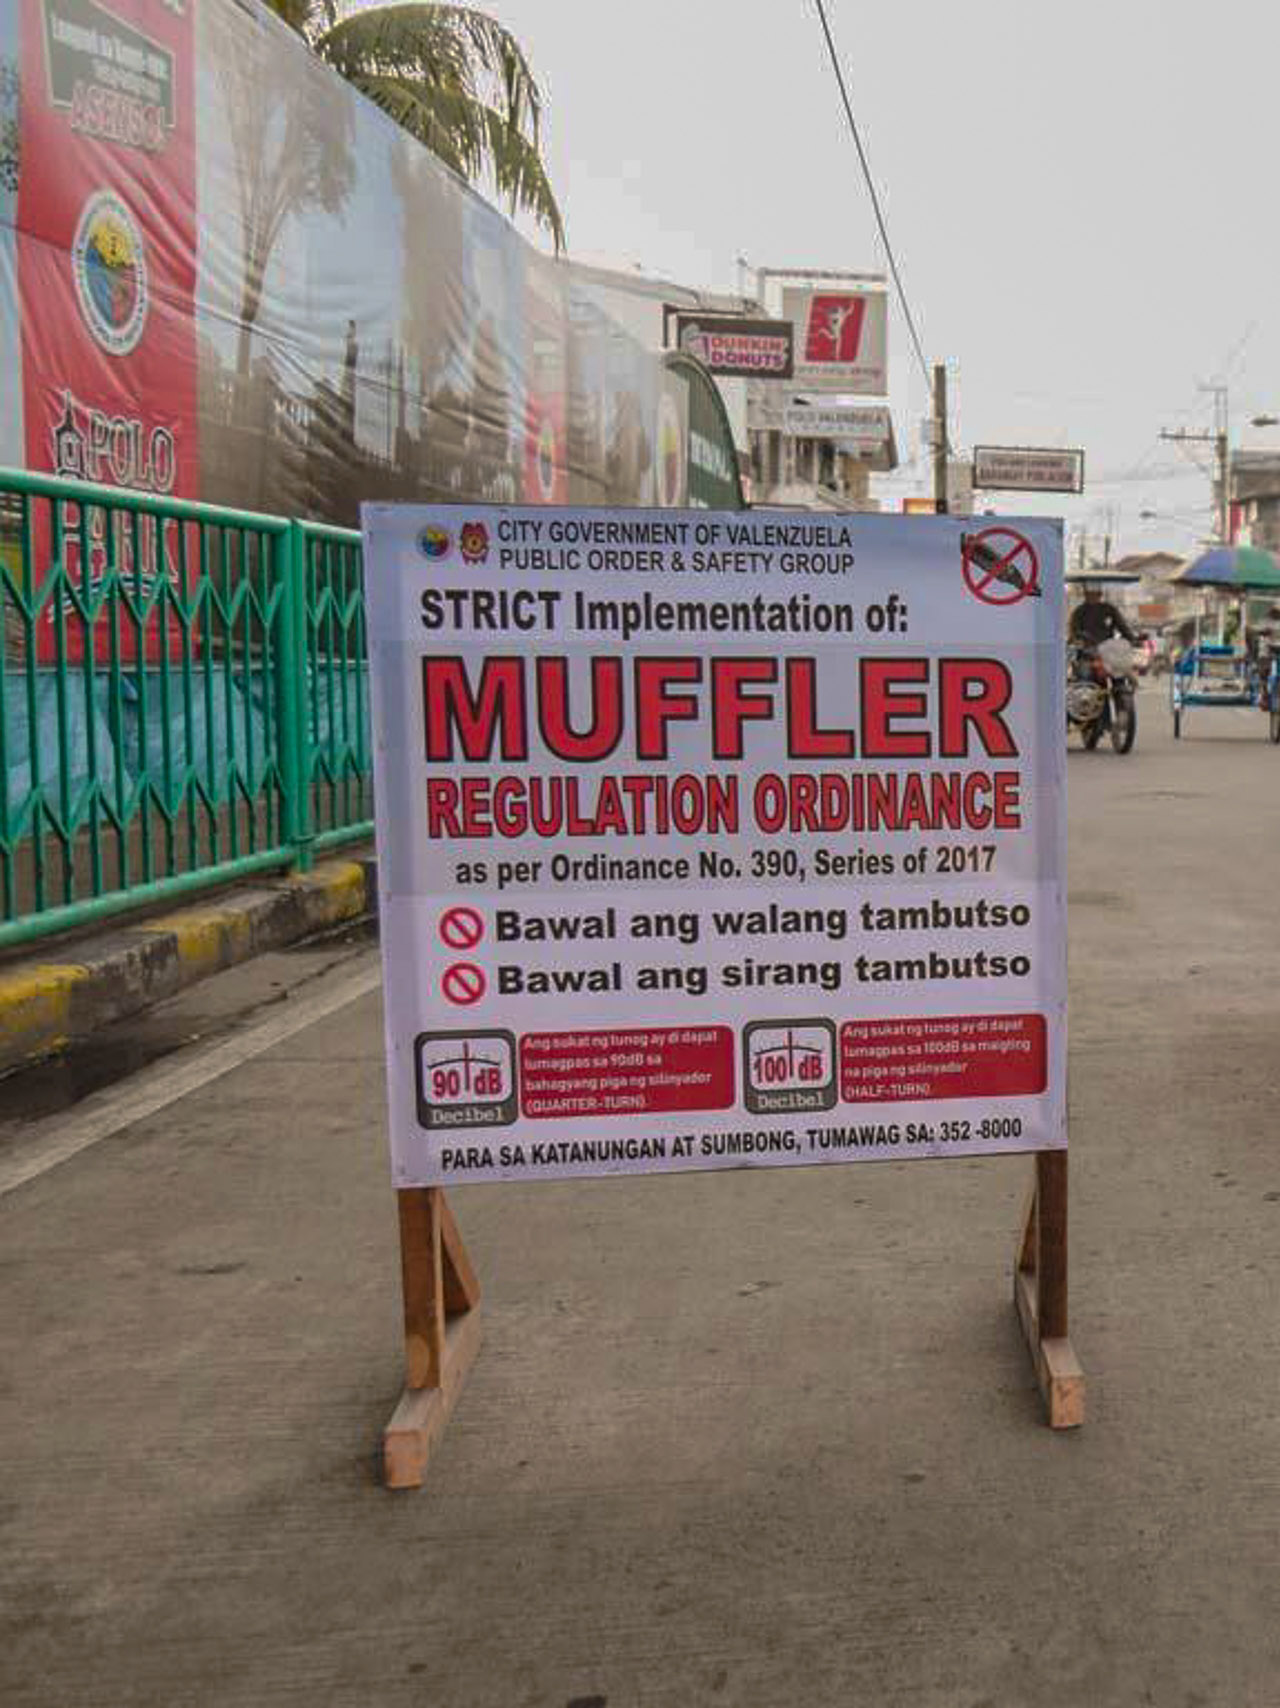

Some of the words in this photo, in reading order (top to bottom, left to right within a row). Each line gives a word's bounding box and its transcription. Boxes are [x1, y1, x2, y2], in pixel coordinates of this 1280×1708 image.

[711, 352, 784, 366] DONUTS
[87, 409, 174, 492] POLO
[498, 520, 544, 543] CITY
[550, 521, 690, 545] GOVERNMENT
[695, 523, 721, 545] OF
[727, 524, 852, 548] VALENZUELA
[500, 549, 581, 570] PUBLIC
[587, 549, 665, 572] ORDER
[670, 551, 687, 572] &
[692, 552, 773, 573] SAFETY
[779, 552, 855, 575] GROUP
[421, 588, 562, 631] STRICT
[575, 591, 854, 640] Implementation
[865, 594, 908, 632] of:
[421, 655, 1020, 764] MUFFLER
[426, 774, 740, 839] REGULATION
[753, 771, 1023, 834] ORDINANCE
[455, 862, 488, 884] as
[497, 861, 543, 890] per
[550, 853, 690, 882] Ordinance
[699, 851, 742, 879] No.
[751, 850, 807, 883] 390,
[814, 848, 895, 876] Series
[903, 846, 929, 874] of
[936, 845, 998, 873] 2017
[495, 907, 616, 942] Bawal
[630, 911, 700, 944] ang
[711, 903, 848, 940] walang
[860, 899, 1031, 931] tambutso
[498, 962, 622, 995] Bawal
[636, 965, 708, 996] ang
[721, 958, 842, 991] sirang
[854, 951, 1031, 983] tambutso
[525, 1036, 550, 1050] Ang
[592, 1036, 608, 1049] ng
[611, 1034, 648, 1048] tunog
[651, 1035, 665, 1047] ay
[844, 1025, 869, 1039] Ang
[907, 1025, 922, 1038] ng
[961, 1023, 975, 1035] ay
[593, 1057, 608, 1067] sa
[647, 1055, 662, 1066] sa
[906, 1044, 922, 1054] sa
[961, 1042, 977, 1052] sa
[431, 1069, 460, 1099] 90
[474, 1067, 503, 1097] dB
[600, 1076, 628, 1090] piga
[630, 1076, 646, 1088] ng
[754, 1056, 788, 1084] 100
[798, 1056, 824, 1082] dB
[844, 1067, 860, 1077] na
[862, 1066, 888, 1079] piga
[890, 1066, 906, 1077] ng
[757, 1090, 825, 1109] Decibel
[431, 1104, 504, 1125] Decibel
[441, 1147, 494, 1170] PARA
[499, 1145, 526, 1166] SA
[532, 1138, 666, 1165] KATANUNGAN
[671, 1135, 696, 1157] AT
[703, 1130, 801, 1156] SUMBONG,
[806, 1124, 900, 1150] TUMAWAG
[906, 1122, 935, 1143] SA:
